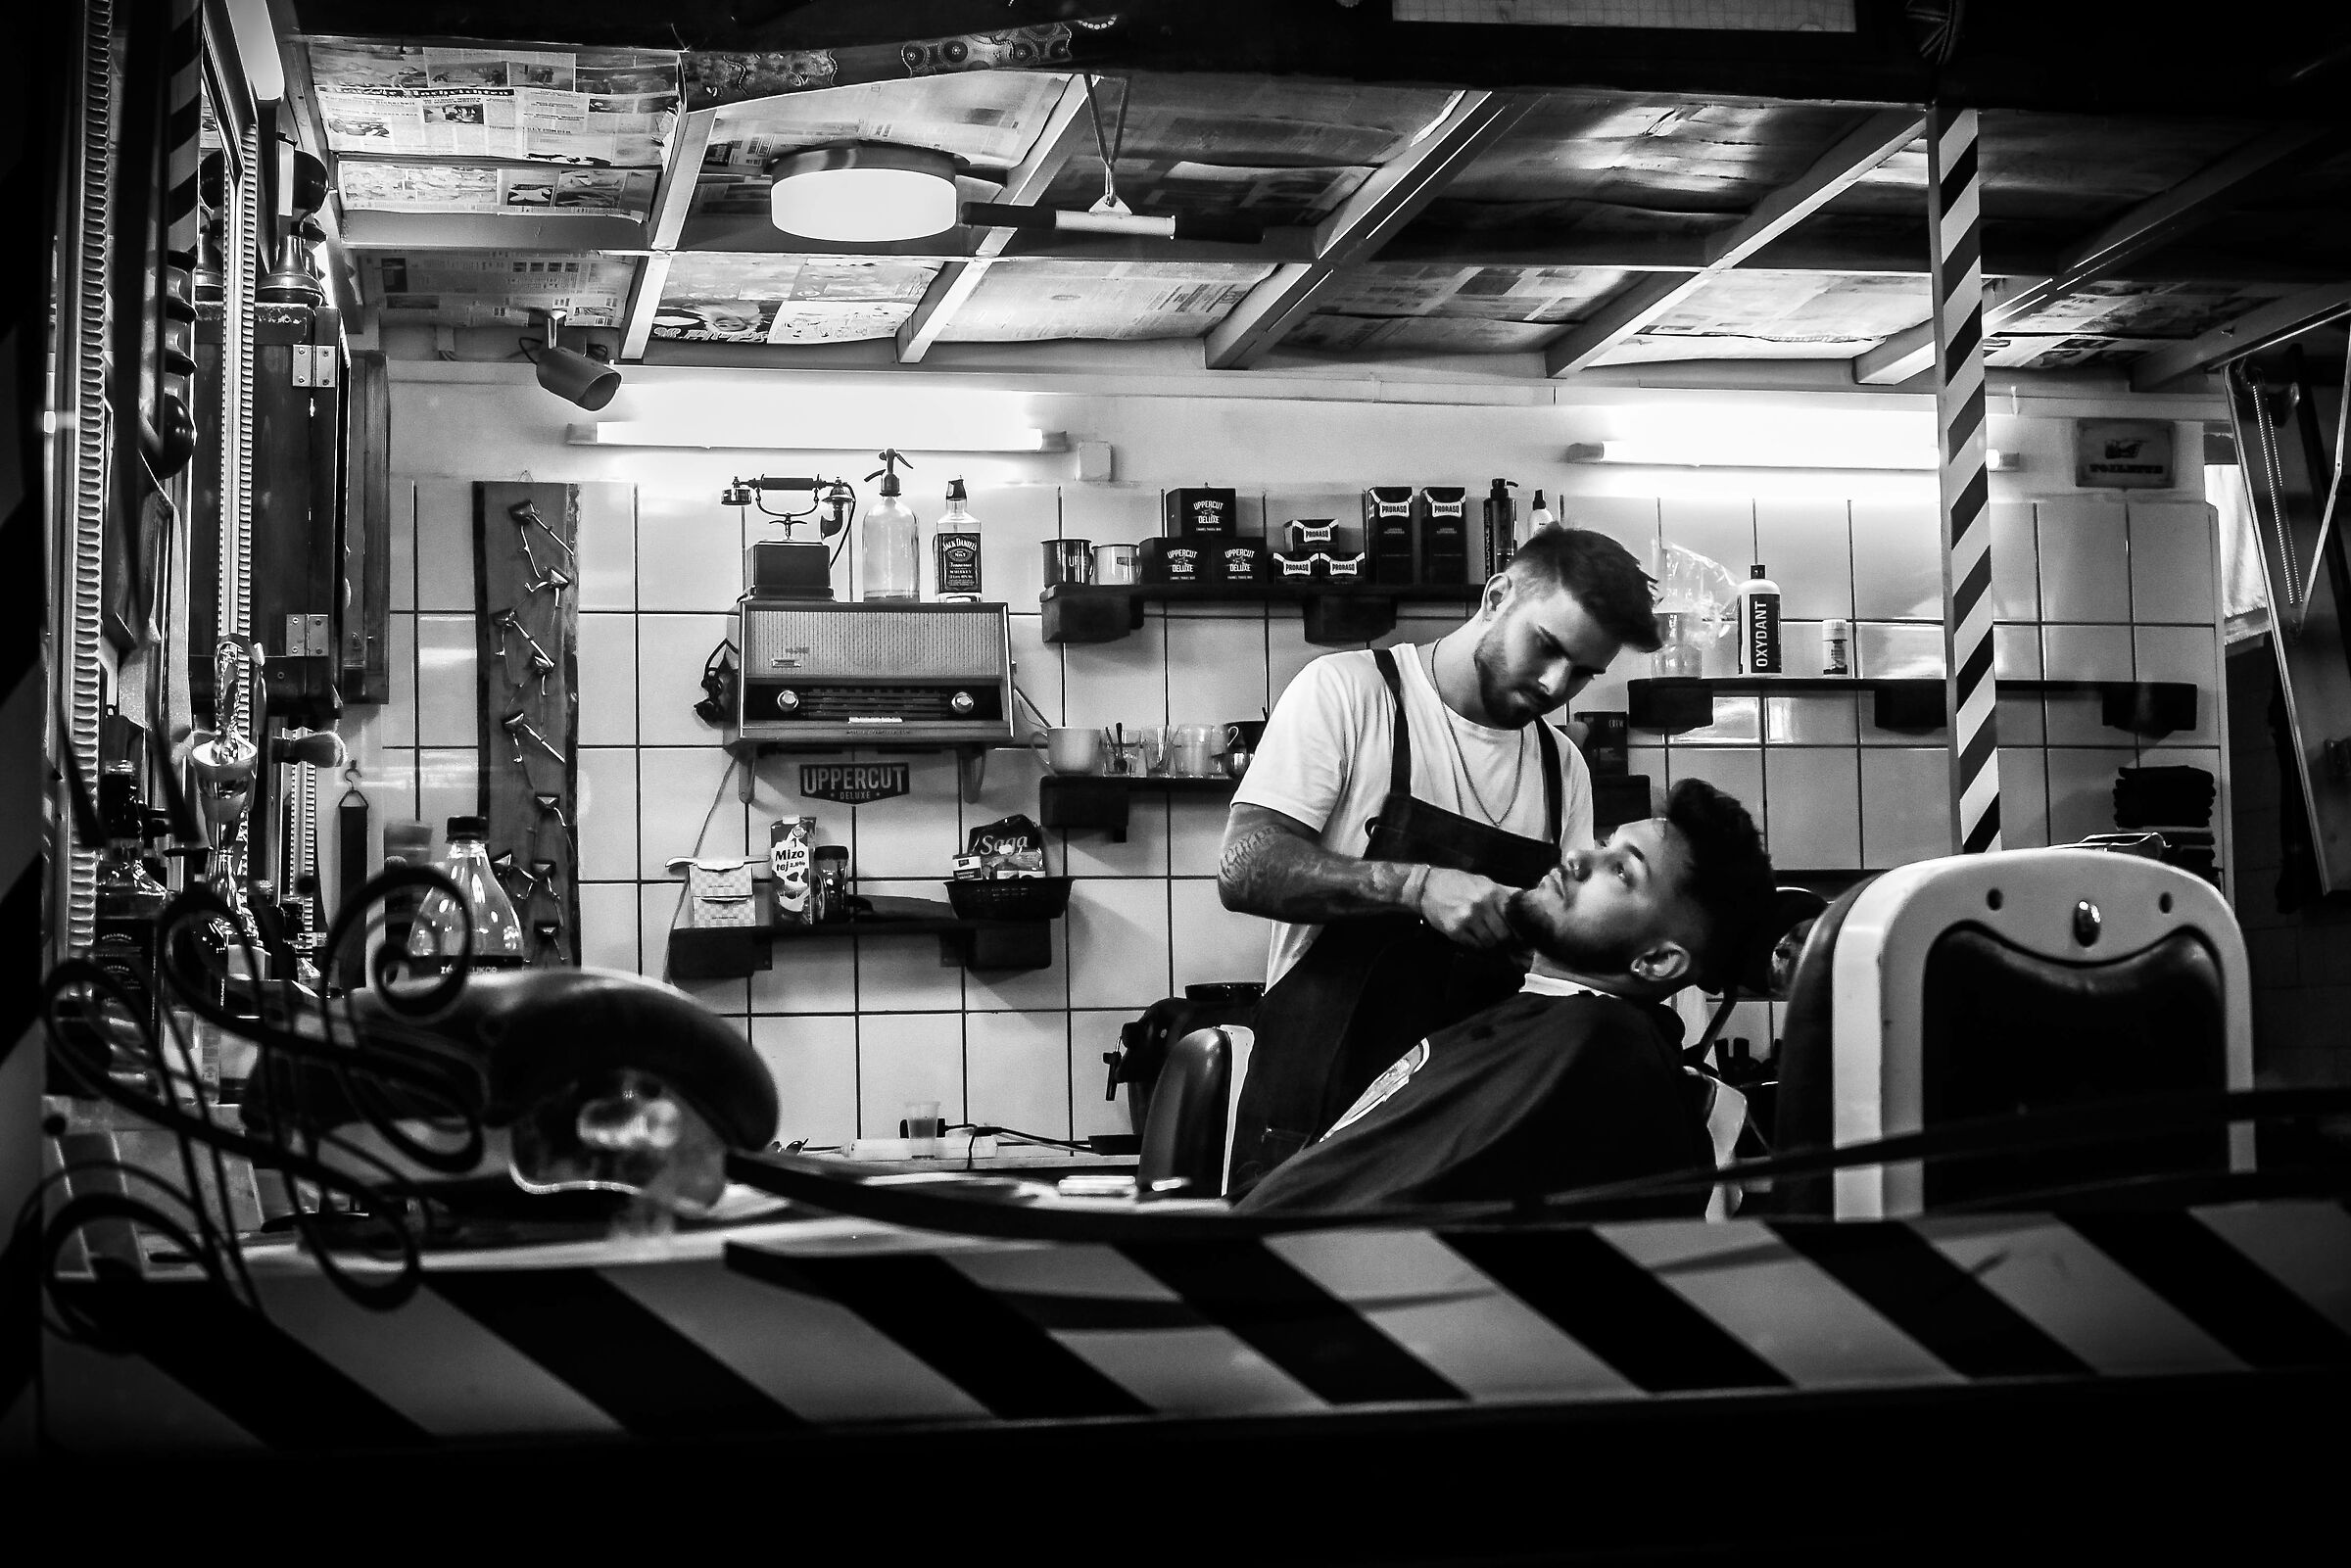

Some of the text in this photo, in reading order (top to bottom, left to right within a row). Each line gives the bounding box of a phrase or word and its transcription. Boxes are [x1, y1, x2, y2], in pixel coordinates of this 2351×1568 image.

[1193, 500, 1223, 510] UPPERCUT
[1381, 505, 1408, 514] PRORASO
[1434, 505, 1460, 514] PRORASO
[1198, 514, 1220, 524] DELUXE
[1305, 530, 1329, 539] PRORASO
[1167, 548, 1198, 559] UPPERCUT
[1224, 548, 1255, 558] UPPERCUT
[1172, 563, 1194, 573] DELUXE
[1229, 562, 1251, 572] DELUXE
[1285, 563, 1310, 572] PRORASO
[1331, 563, 1356, 572] PRORASO
[1754, 600, 1768, 667] OXYDANT
[803, 766, 905, 794] UPPERCUT
[840, 790, 871, 800] DELUXE
[980, 835, 1028, 856] Saga
[775, 849, 804, 861] Mizo
[776, 862, 790, 872] tej
